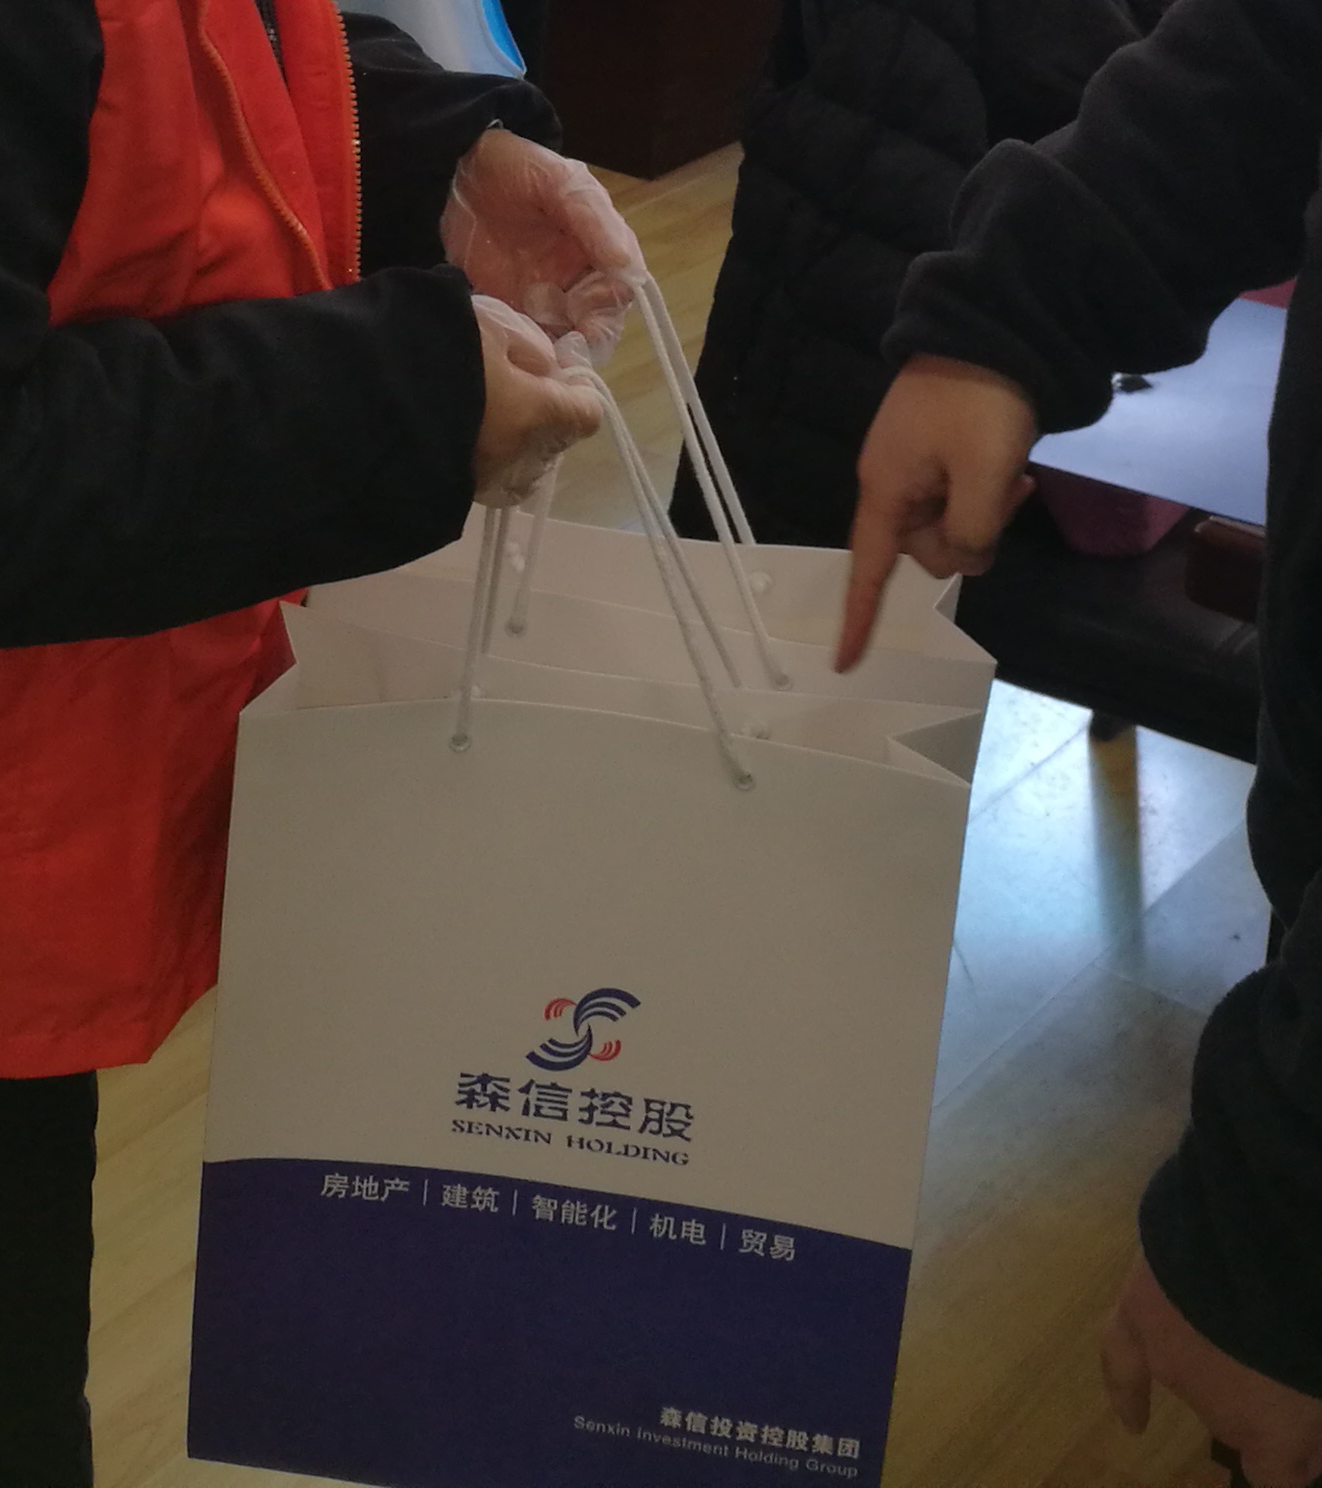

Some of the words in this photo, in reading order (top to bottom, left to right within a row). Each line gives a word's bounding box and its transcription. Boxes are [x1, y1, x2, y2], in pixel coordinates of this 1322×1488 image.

[455, 1072, 694, 1143] 森信控股
[451, 1118, 553, 1145] SENXIN
[566, 1134, 690, 1167] HOLDING
[320, 1172, 411, 1203] 房地产
[441, 1183, 500, 1213] 建筑
[531, 1194, 618, 1231] 智能化
[649, 1213, 708, 1246] 机电
[738, 1228, 797, 1262] 贸易
[573, 1415, 630, 1438] Senxin
[637, 1426, 730, 1457] Investment
[734, 1445, 800, 1471] Holding
[805, 1458, 859, 1480] Group
[660, 1406, 861, 1459] 森信投资控股集团
